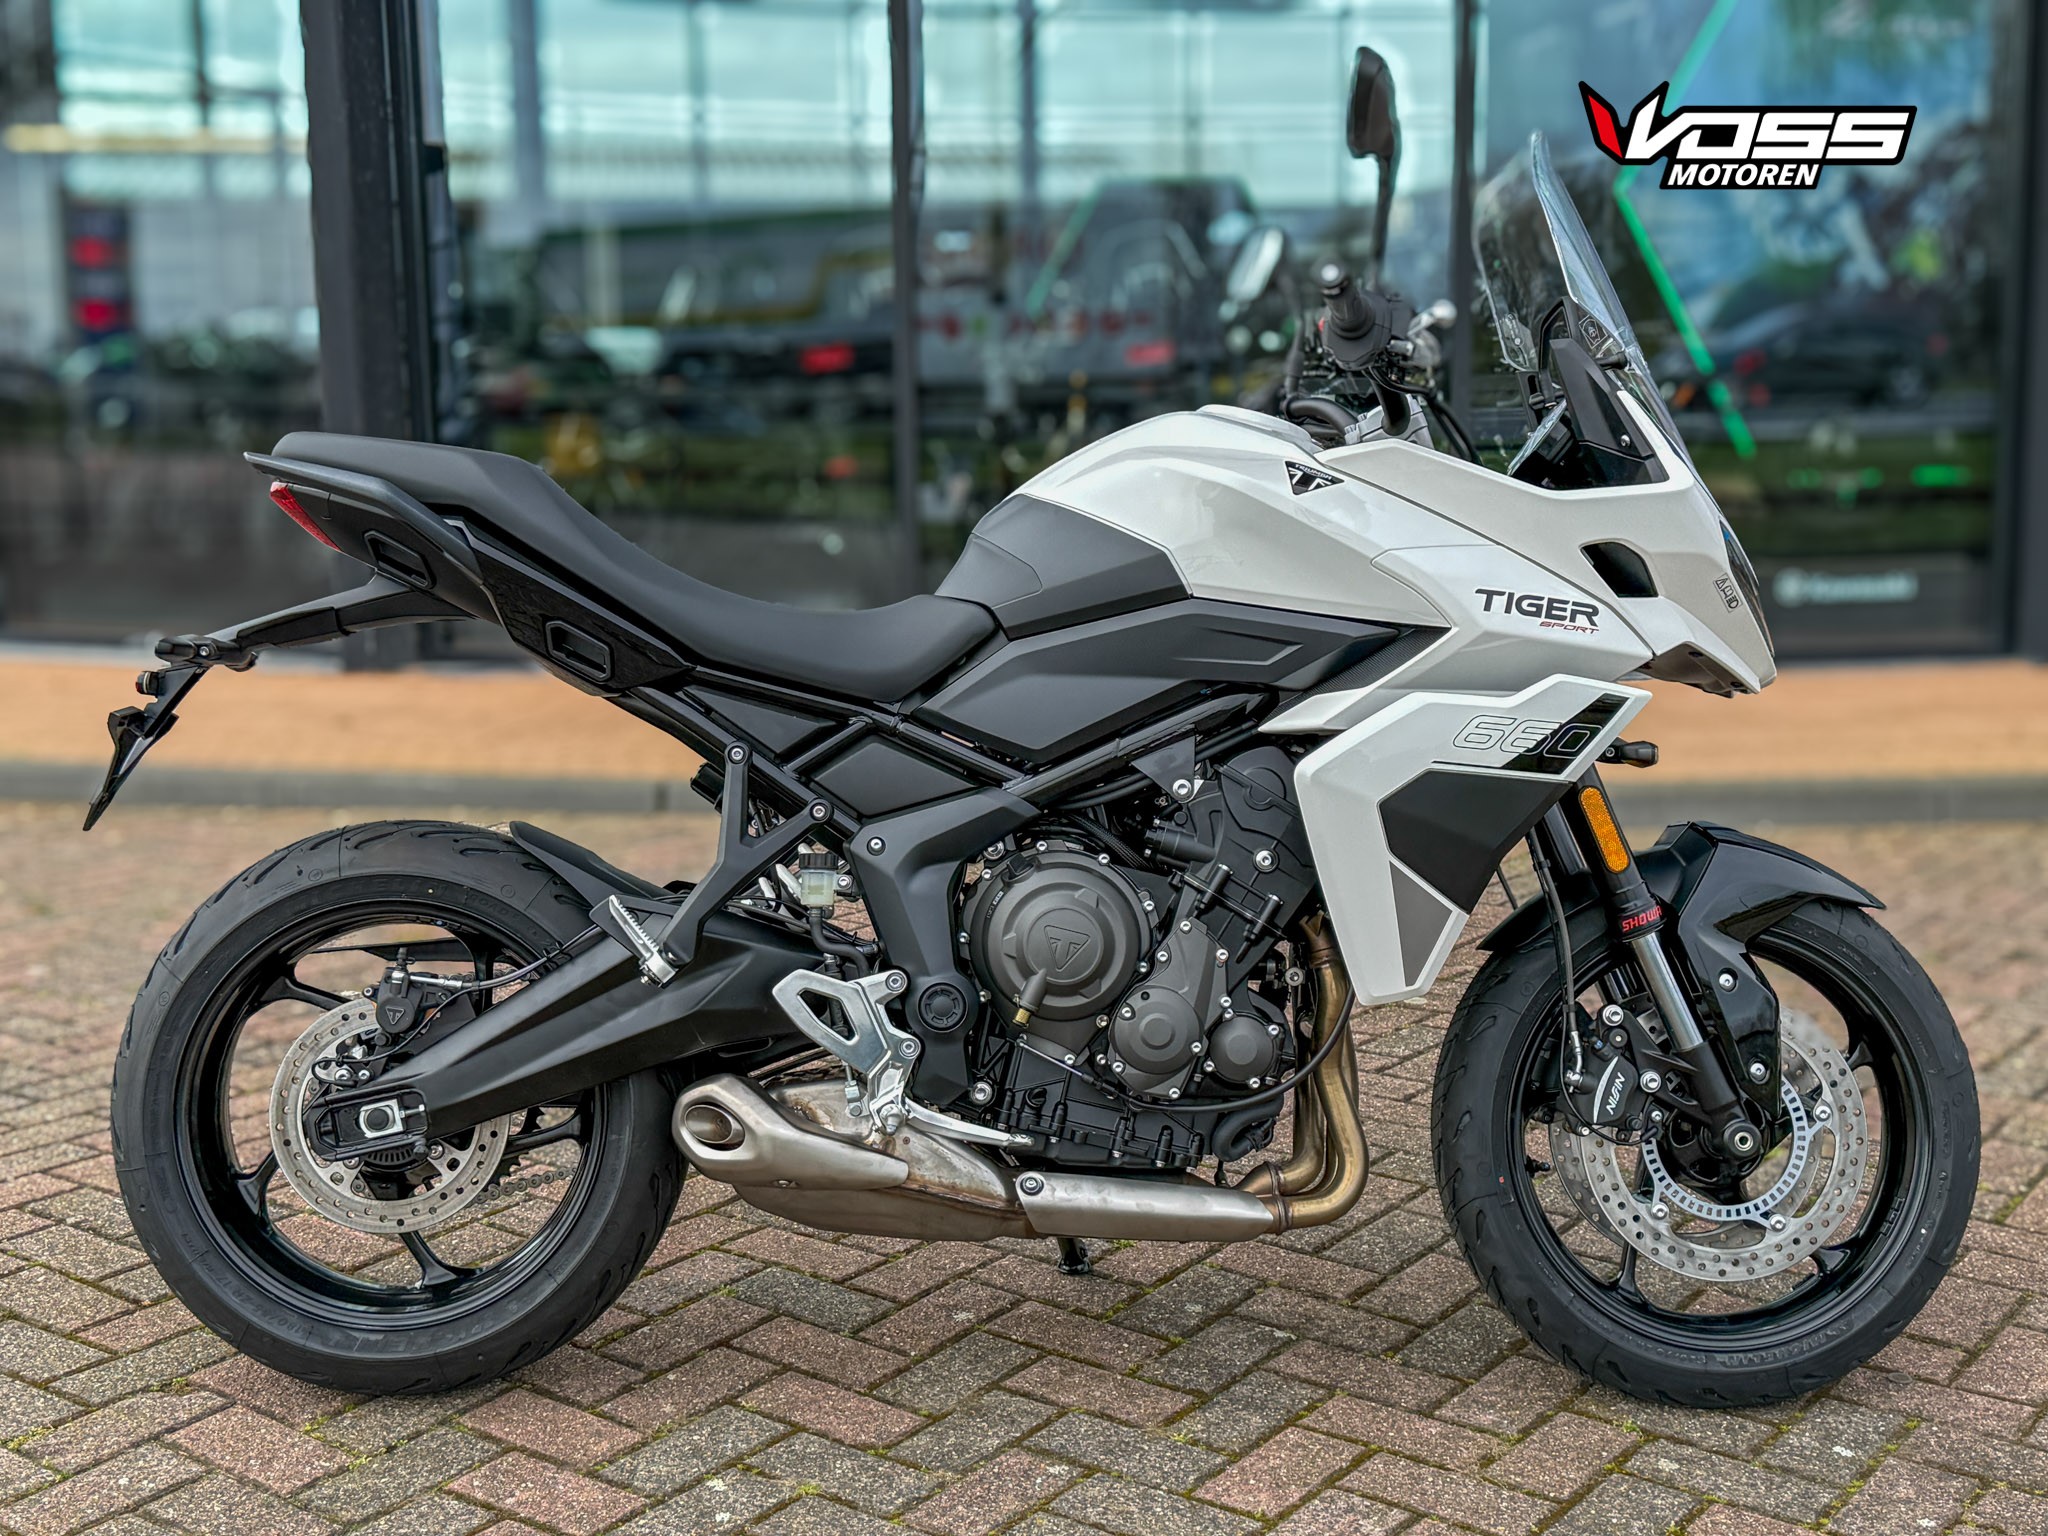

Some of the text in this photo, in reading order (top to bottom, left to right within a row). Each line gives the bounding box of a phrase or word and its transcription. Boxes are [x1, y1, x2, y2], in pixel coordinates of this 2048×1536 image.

[1475, 588, 1600, 628] TIGER
[1539, 620, 1600, 635] SPORT
[1452, 714, 1604, 759] 660
[1622, 904, 1663, 932] SHOWA
